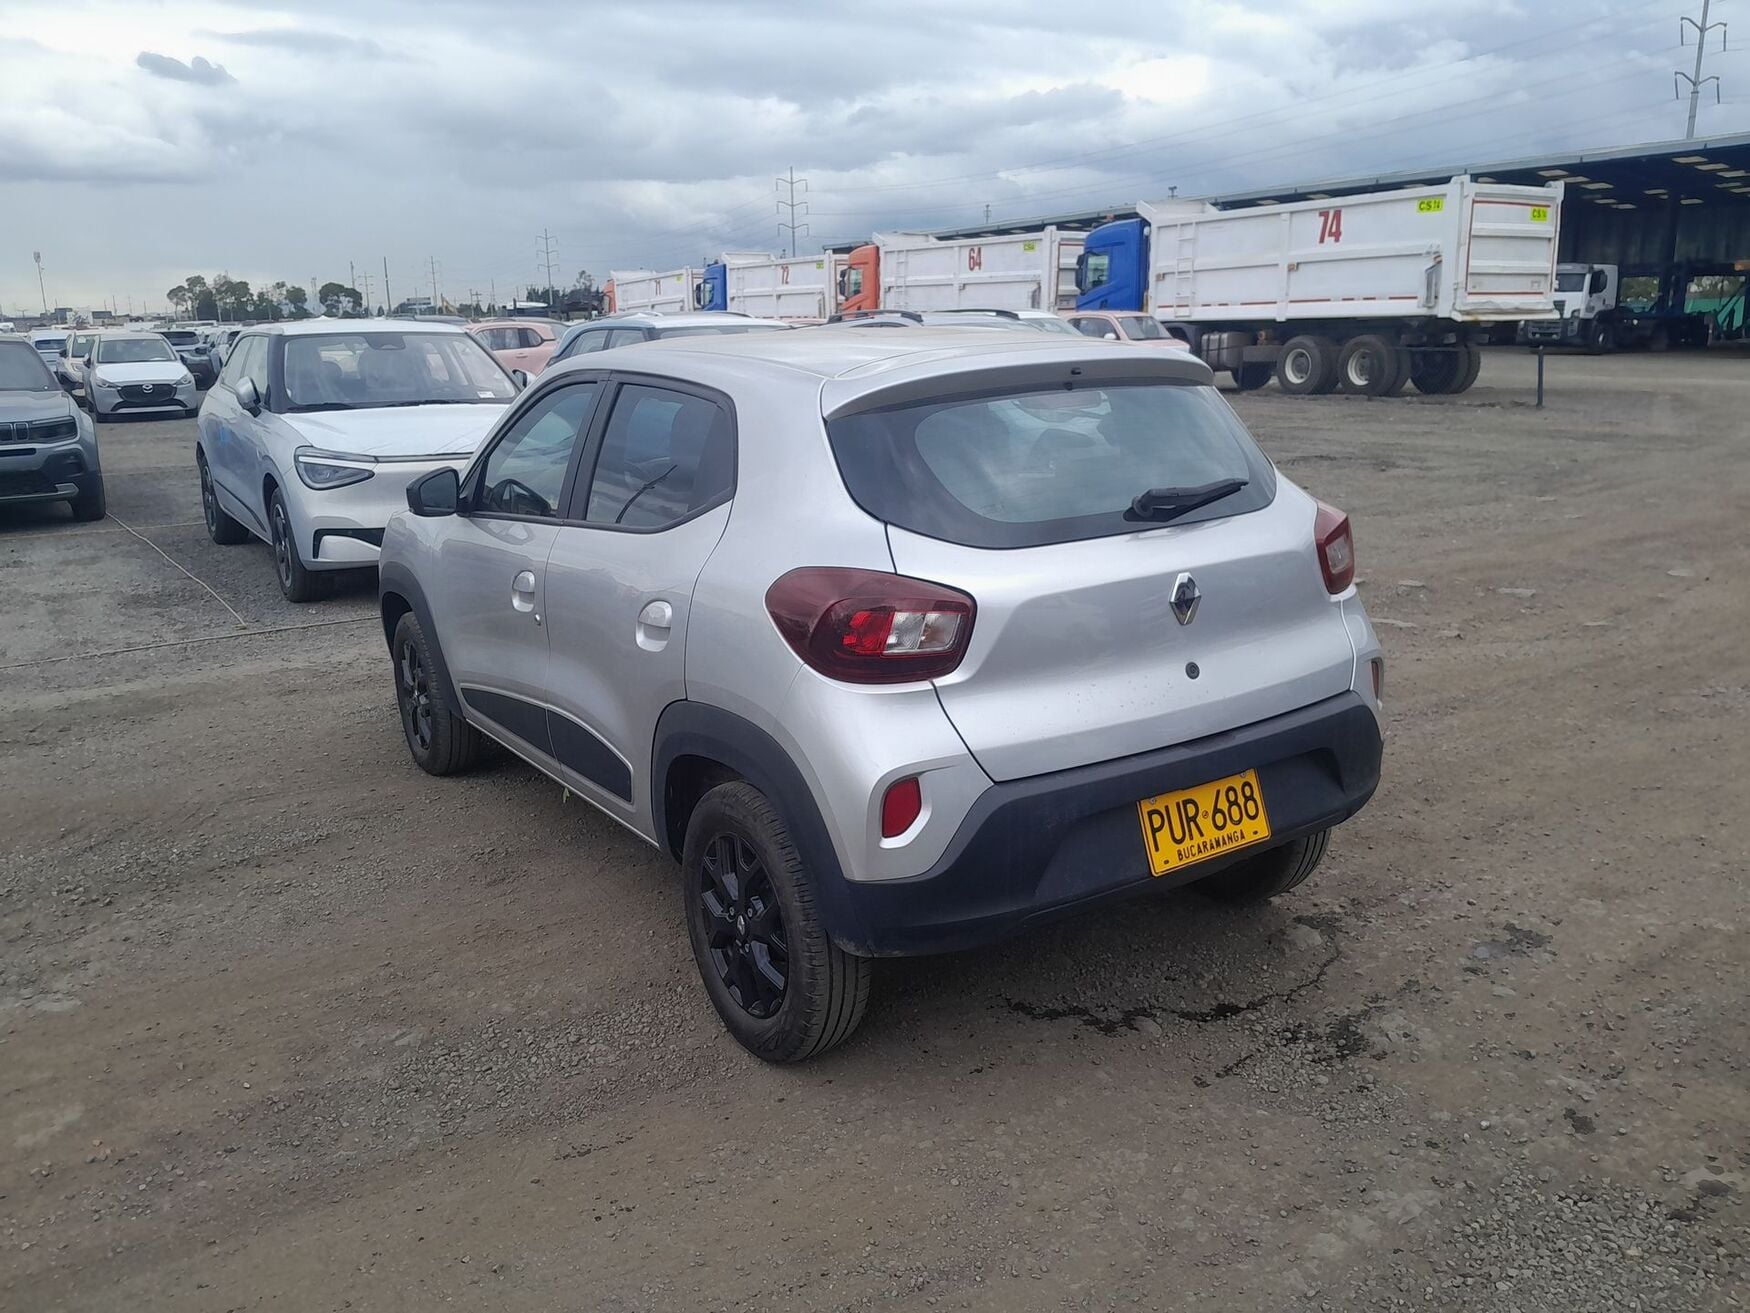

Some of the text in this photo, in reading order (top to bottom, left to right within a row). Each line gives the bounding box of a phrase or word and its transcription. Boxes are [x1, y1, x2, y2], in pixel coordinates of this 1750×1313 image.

[1318, 209, 1342, 244] 74
[968, 246, 982, 272] 64
[1147, 781, 1260, 853] PUR 688
[1176, 829, 1246, 862] BUCARAMANGA
